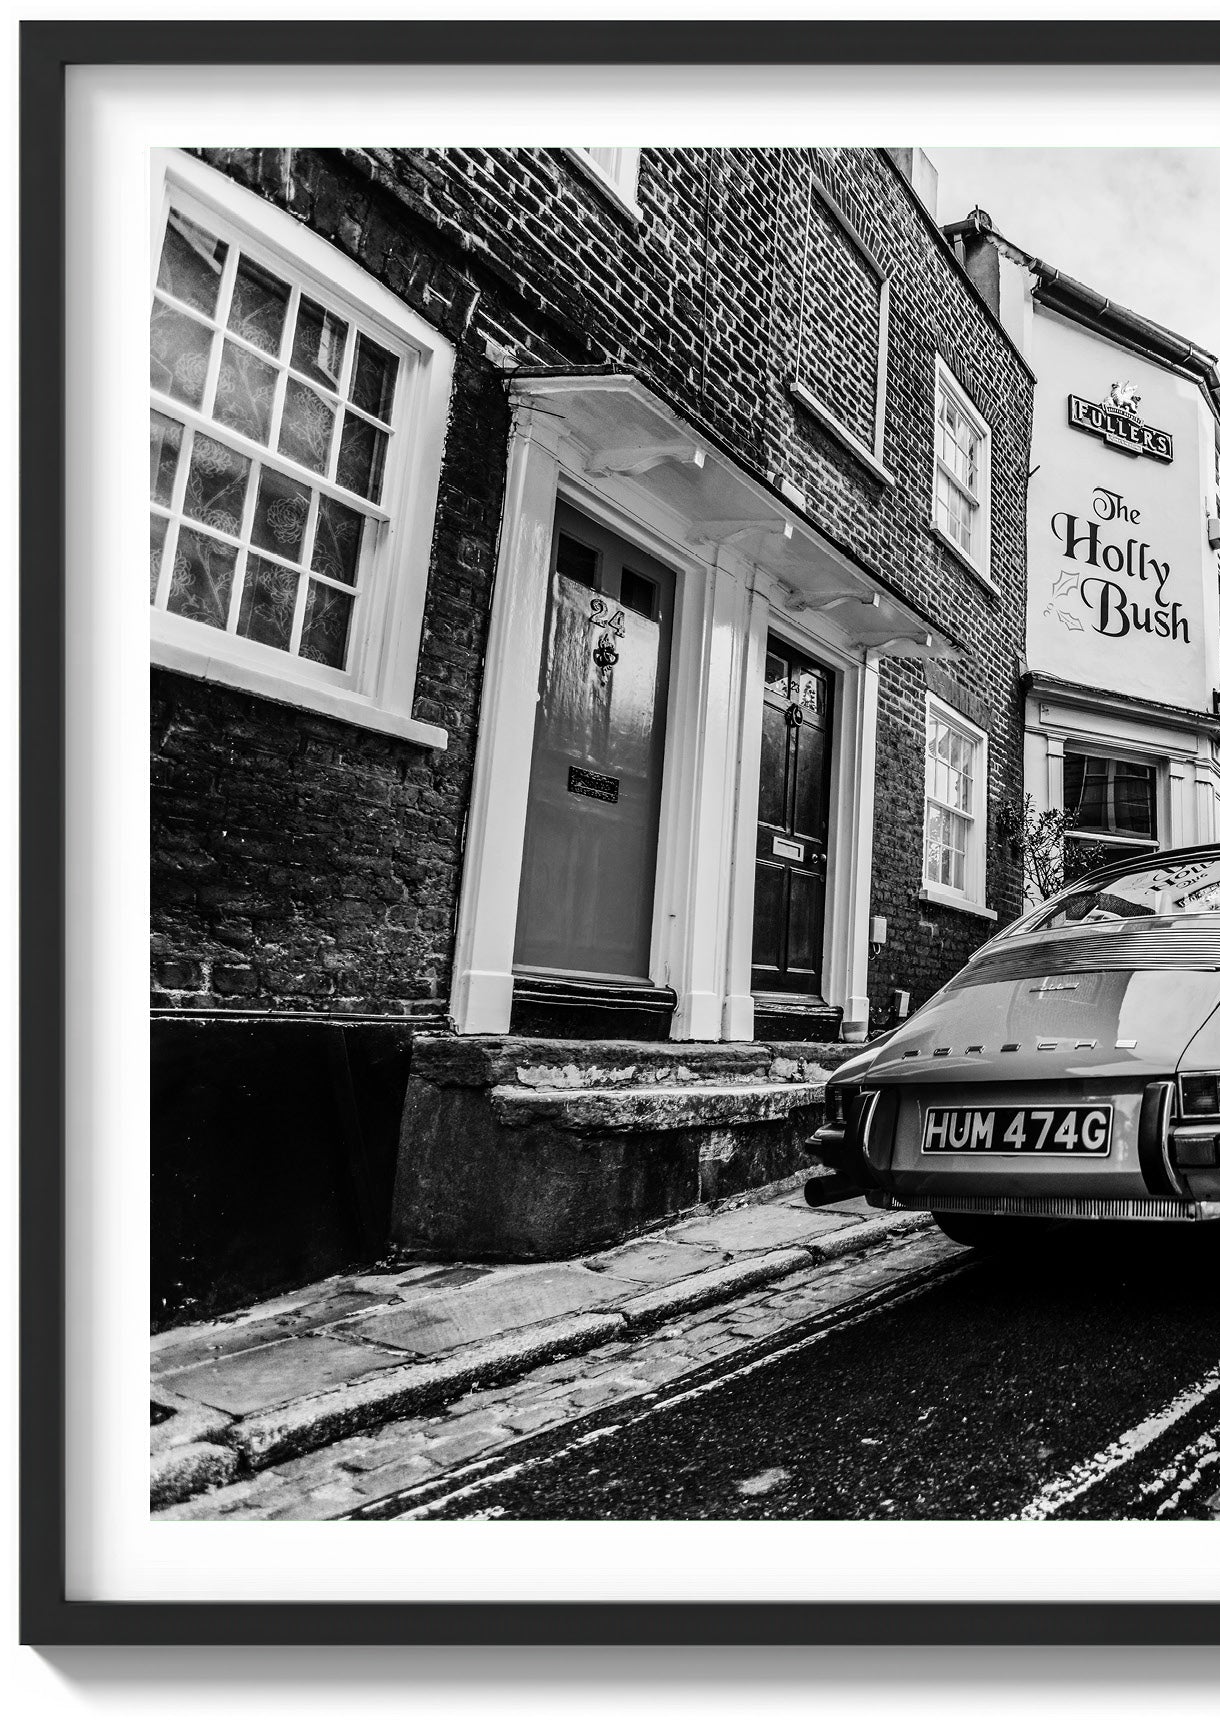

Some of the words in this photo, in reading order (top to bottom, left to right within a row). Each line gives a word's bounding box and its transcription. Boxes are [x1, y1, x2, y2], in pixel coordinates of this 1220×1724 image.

[1092, 485, 1141, 525] The
[1050, 511, 1171, 608] Holly
[589, 598, 626, 639] 24
[1080, 576, 1191, 644] Bush
[902, 1039, 1138, 1060] PORSCHE
[925, 1112, 995, 1149] HUM
[1003, 1110, 1107, 1150] 474G
